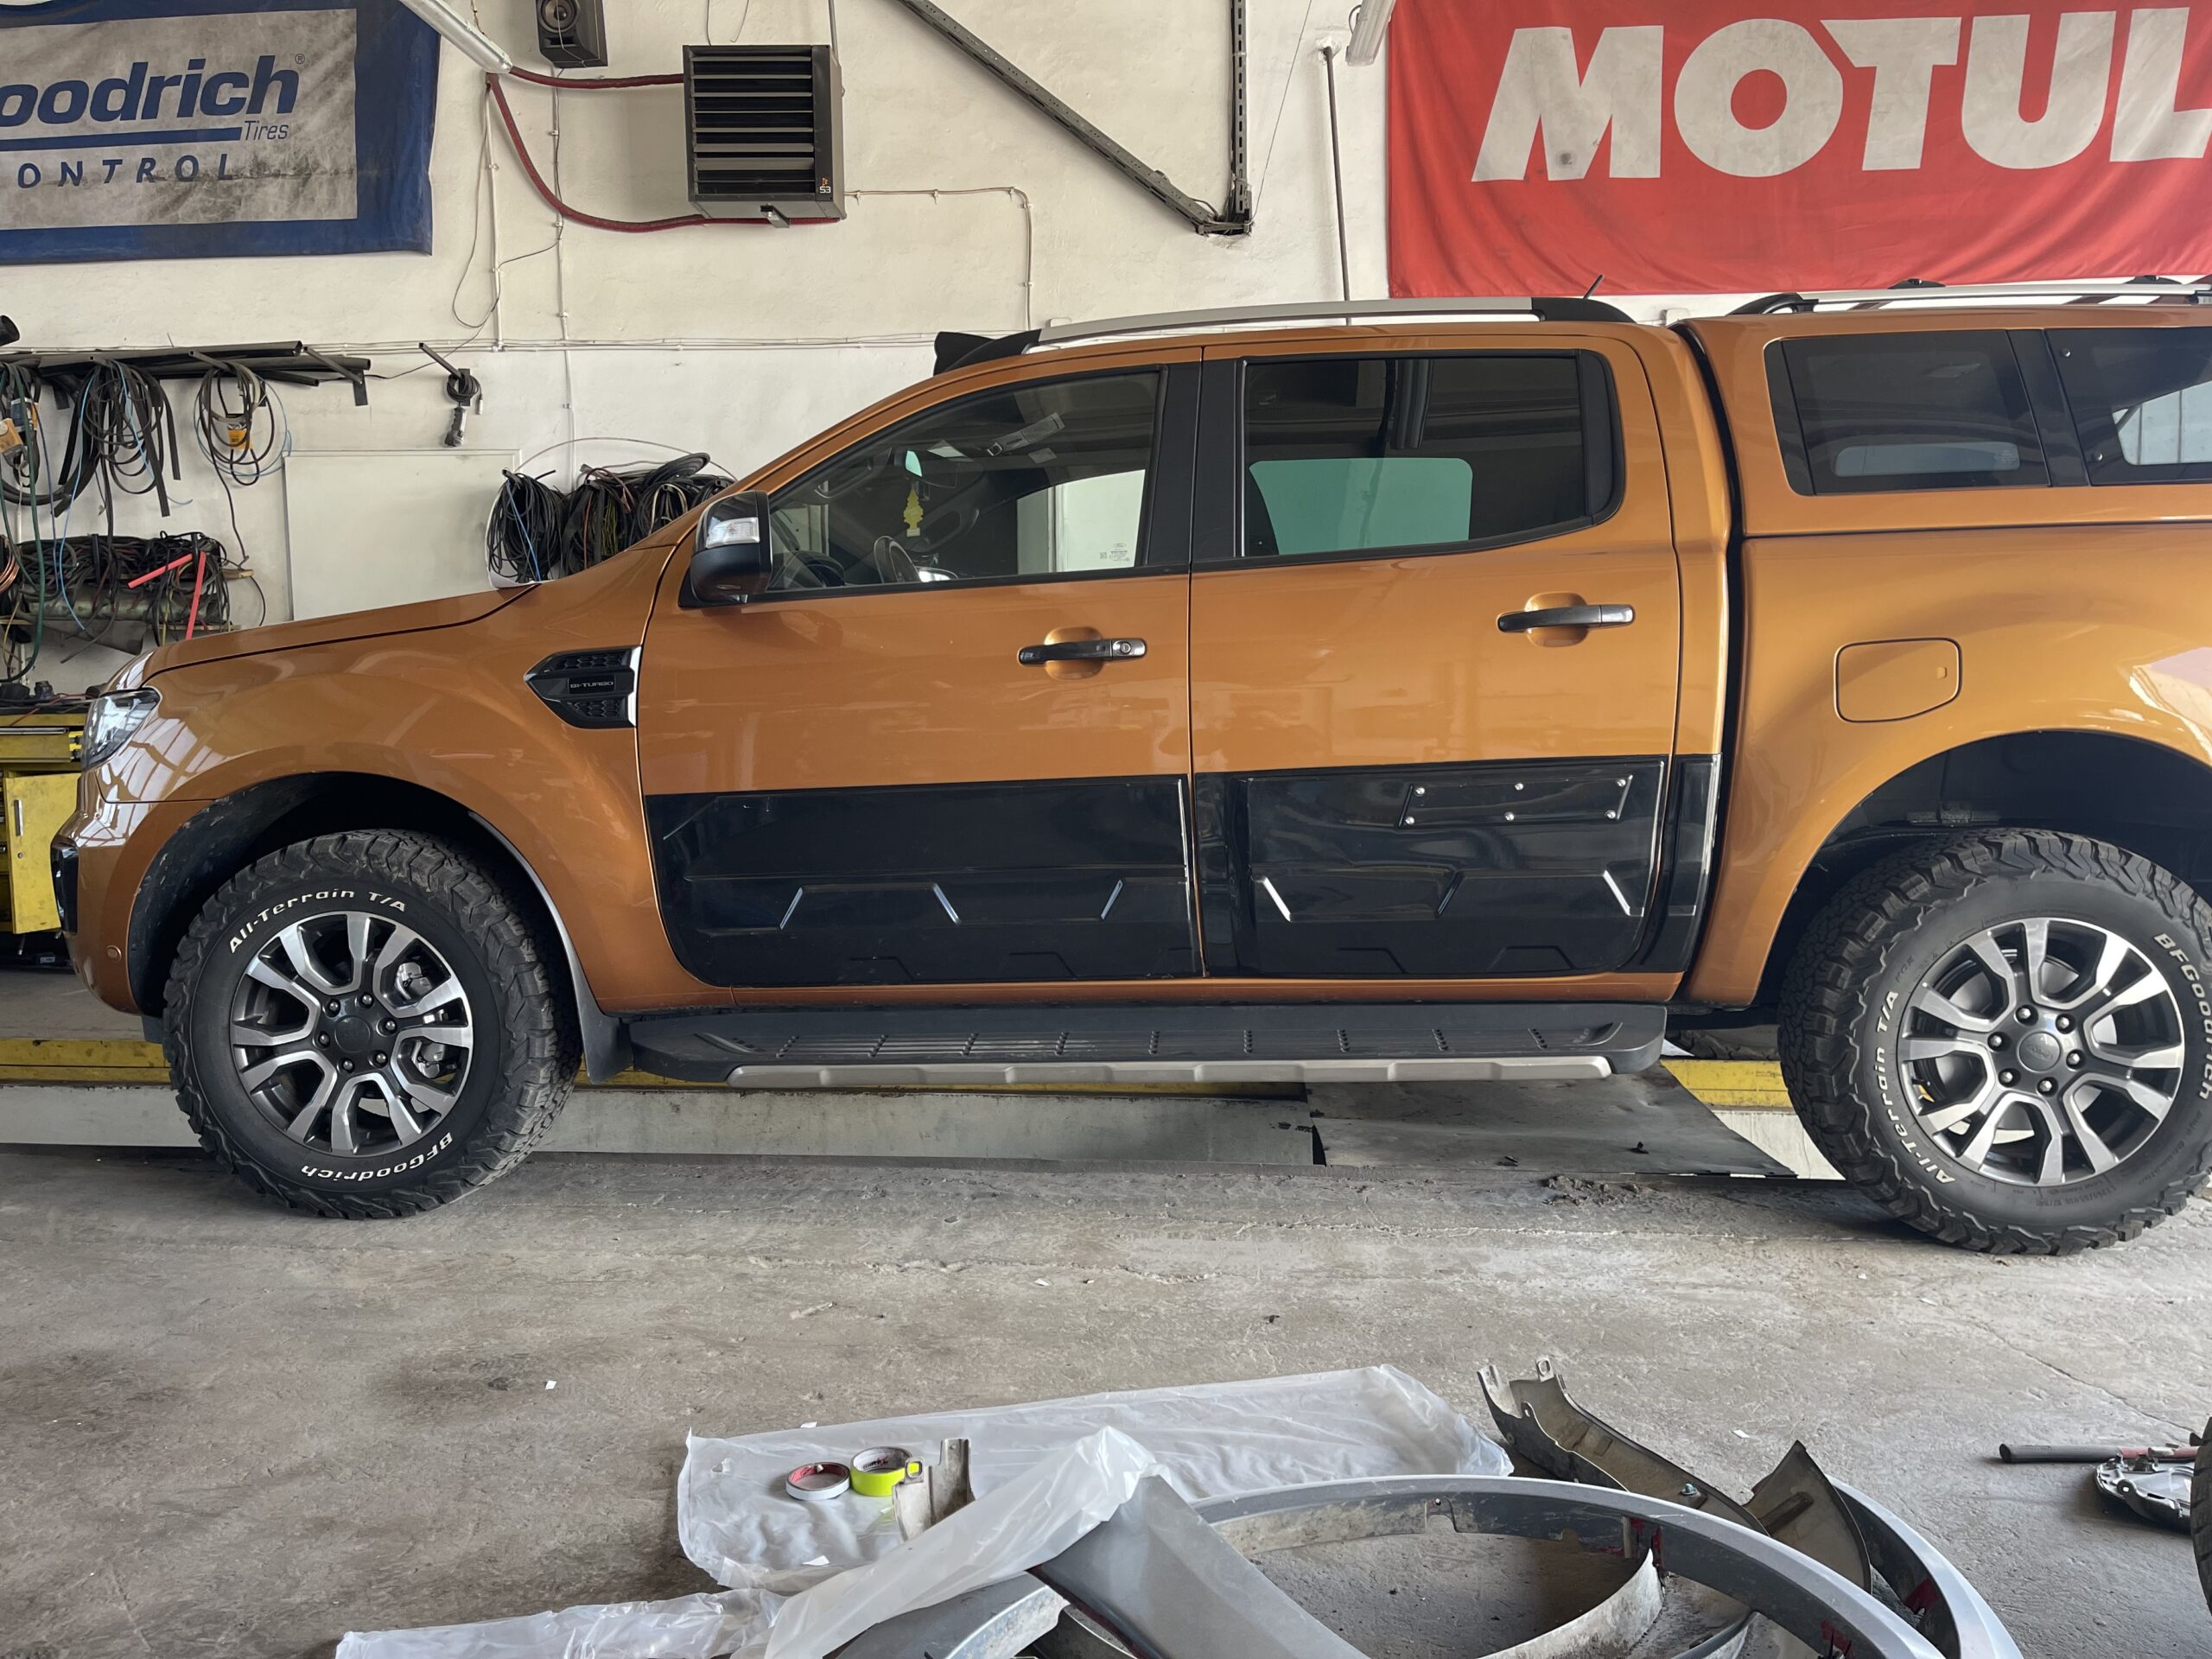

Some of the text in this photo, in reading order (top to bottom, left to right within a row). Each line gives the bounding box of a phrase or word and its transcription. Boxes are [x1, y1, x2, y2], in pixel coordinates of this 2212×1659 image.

[1471, 7, 2212, 181] MOTUL
[245, 120, 289, 141] Tires
[17, 154, 233, 188] ONTROL
[229, 888, 405, 954] All-Terrain T/A
[1874, 991, 1956, 1183] All-Terrain T/A
[302, 1132, 453, 1181] BFGoodrich
